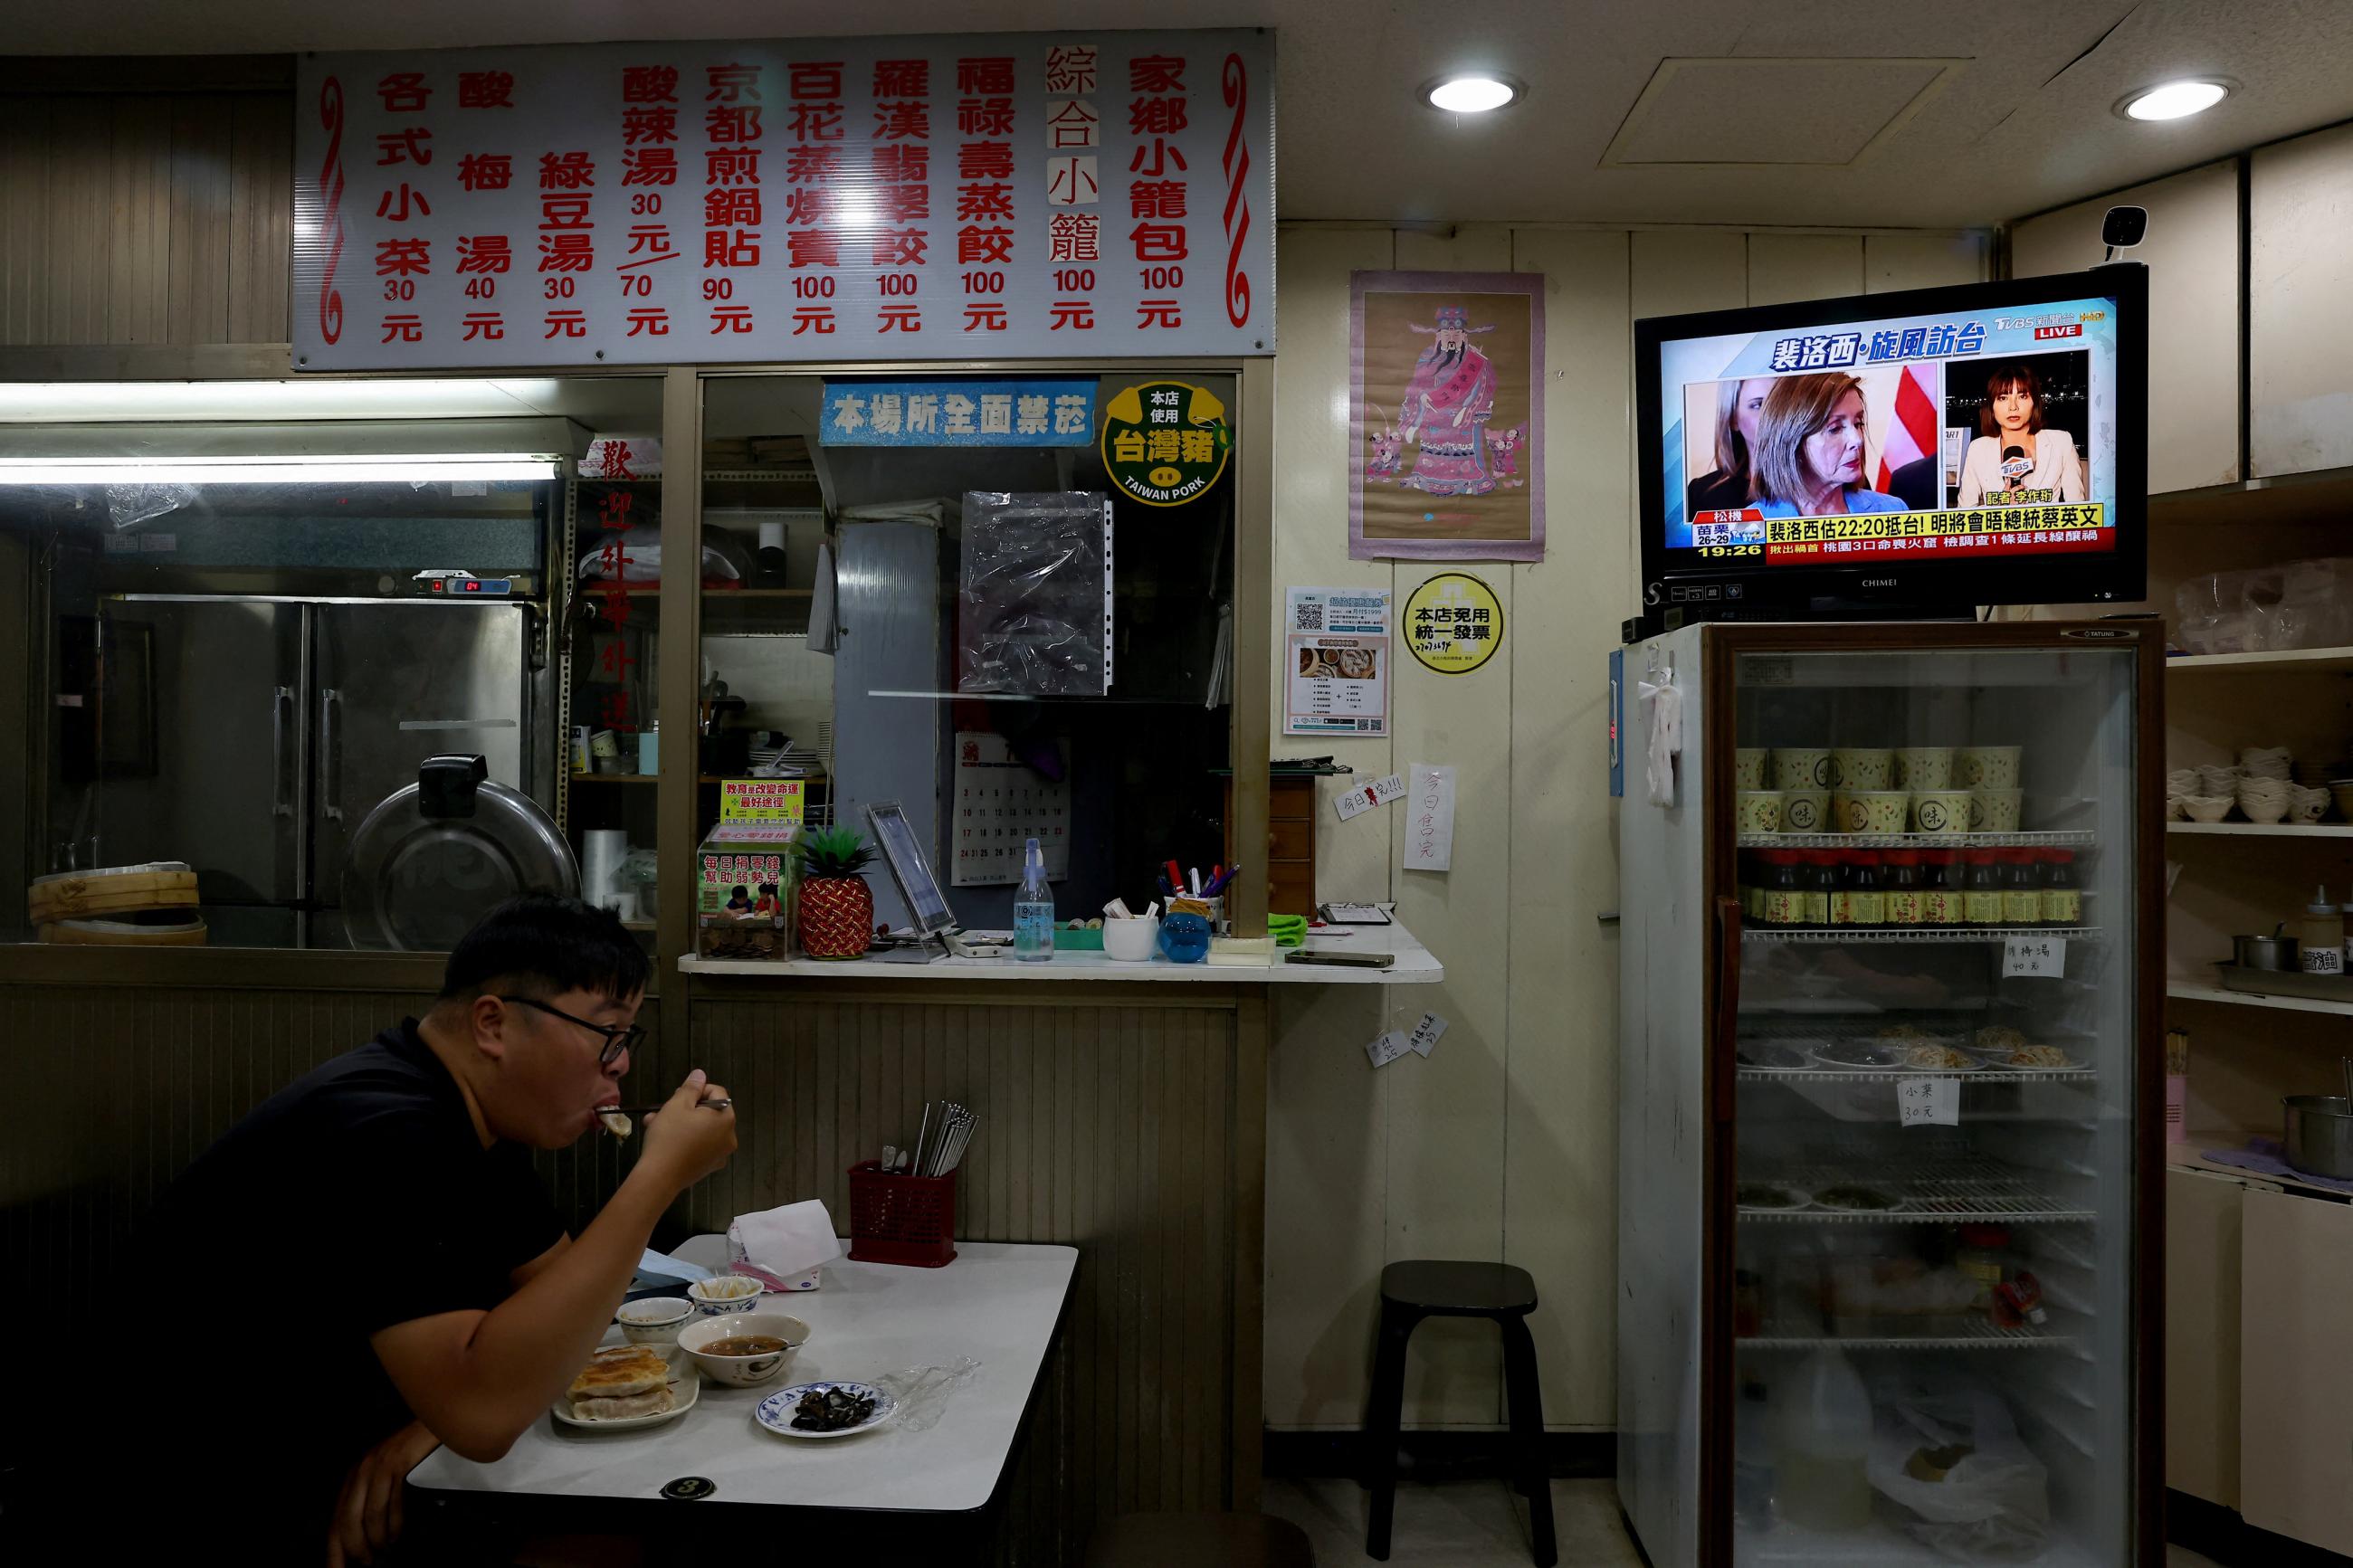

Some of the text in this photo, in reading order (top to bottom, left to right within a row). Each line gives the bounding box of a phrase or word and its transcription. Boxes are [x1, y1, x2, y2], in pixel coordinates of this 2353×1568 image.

[621, 64, 681, 187] 酸辣湯
[871, 59, 930, 267] 羅漢翡翠餃
[956, 56, 1016, 265] 福祿壽蒸餃
[1045, 45, 1101, 262] 綜合小籠
[1128, 54, 1189, 263] 家鄉小籠包
[376, 71, 433, 276] 各式小菜
[456, 71, 516, 274] 酸梅湯
[703, 62, 763, 269] 京都煎鍋貼
[538, 151, 596, 273] 綠豆湯
[630, 193, 662, 215] 30
[464, 276, 496, 299] 40
[543, 276, 576, 299] 30
[620, 274, 653, 298] 70
[702, 278, 734, 300] 90
[792, 275, 836, 299] 100
[876, 273, 918, 297] 100
[961, 271, 1005, 295] 100
[1053, 269, 1096, 292] 100
[1139, 266, 1185, 290] 100
[384, 279, 415, 302] 30
[1995, 317, 2035, 331] TVBS
[2039, 326, 2077, 338] LIVE
[1150, 390, 1179, 406] 本店
[834, 393, 1087, 435] 本場所全面禁菸
[1150, 407, 1179, 424] 使用
[1113, 429, 1215, 464] 台灣豬
[2001, 461, 2029, 474] TVBS
[1123, 474, 1205, 501] TAIWAN PORK
[1986, 490, 2011, 505] 記者
[1713, 510, 1743, 522] 松機
[1697, 524, 1729, 536] 苗栗
[1698, 535, 1729, 546] 26~29
[1698, 545, 1762, 557] 19:26
[1770, 544, 1818, 555] 揪出禍首
[1823, 537, 1938, 553] 桃園3口命喪火窟
[599, 440, 636, 733] 歡迎外帶外送
[1862, 579, 1898, 587] CHIMEI
[1415, 607, 1490, 623] 本店免用
[1415, 624, 1491, 641] 統一發票
[726, 783, 799, 794] 教育是改變命運
[740, 796, 785, 808] 最好途徑
[963, 809, 972, 817] 10
[963, 829, 971, 837] 17
[704, 855, 780, 870] 每日捐零錢
[704, 870, 779, 884] 幫助弱勢兒
[1905, 1083, 1933, 1098] 小菜
[676, 1479, 700, 1493] 3
